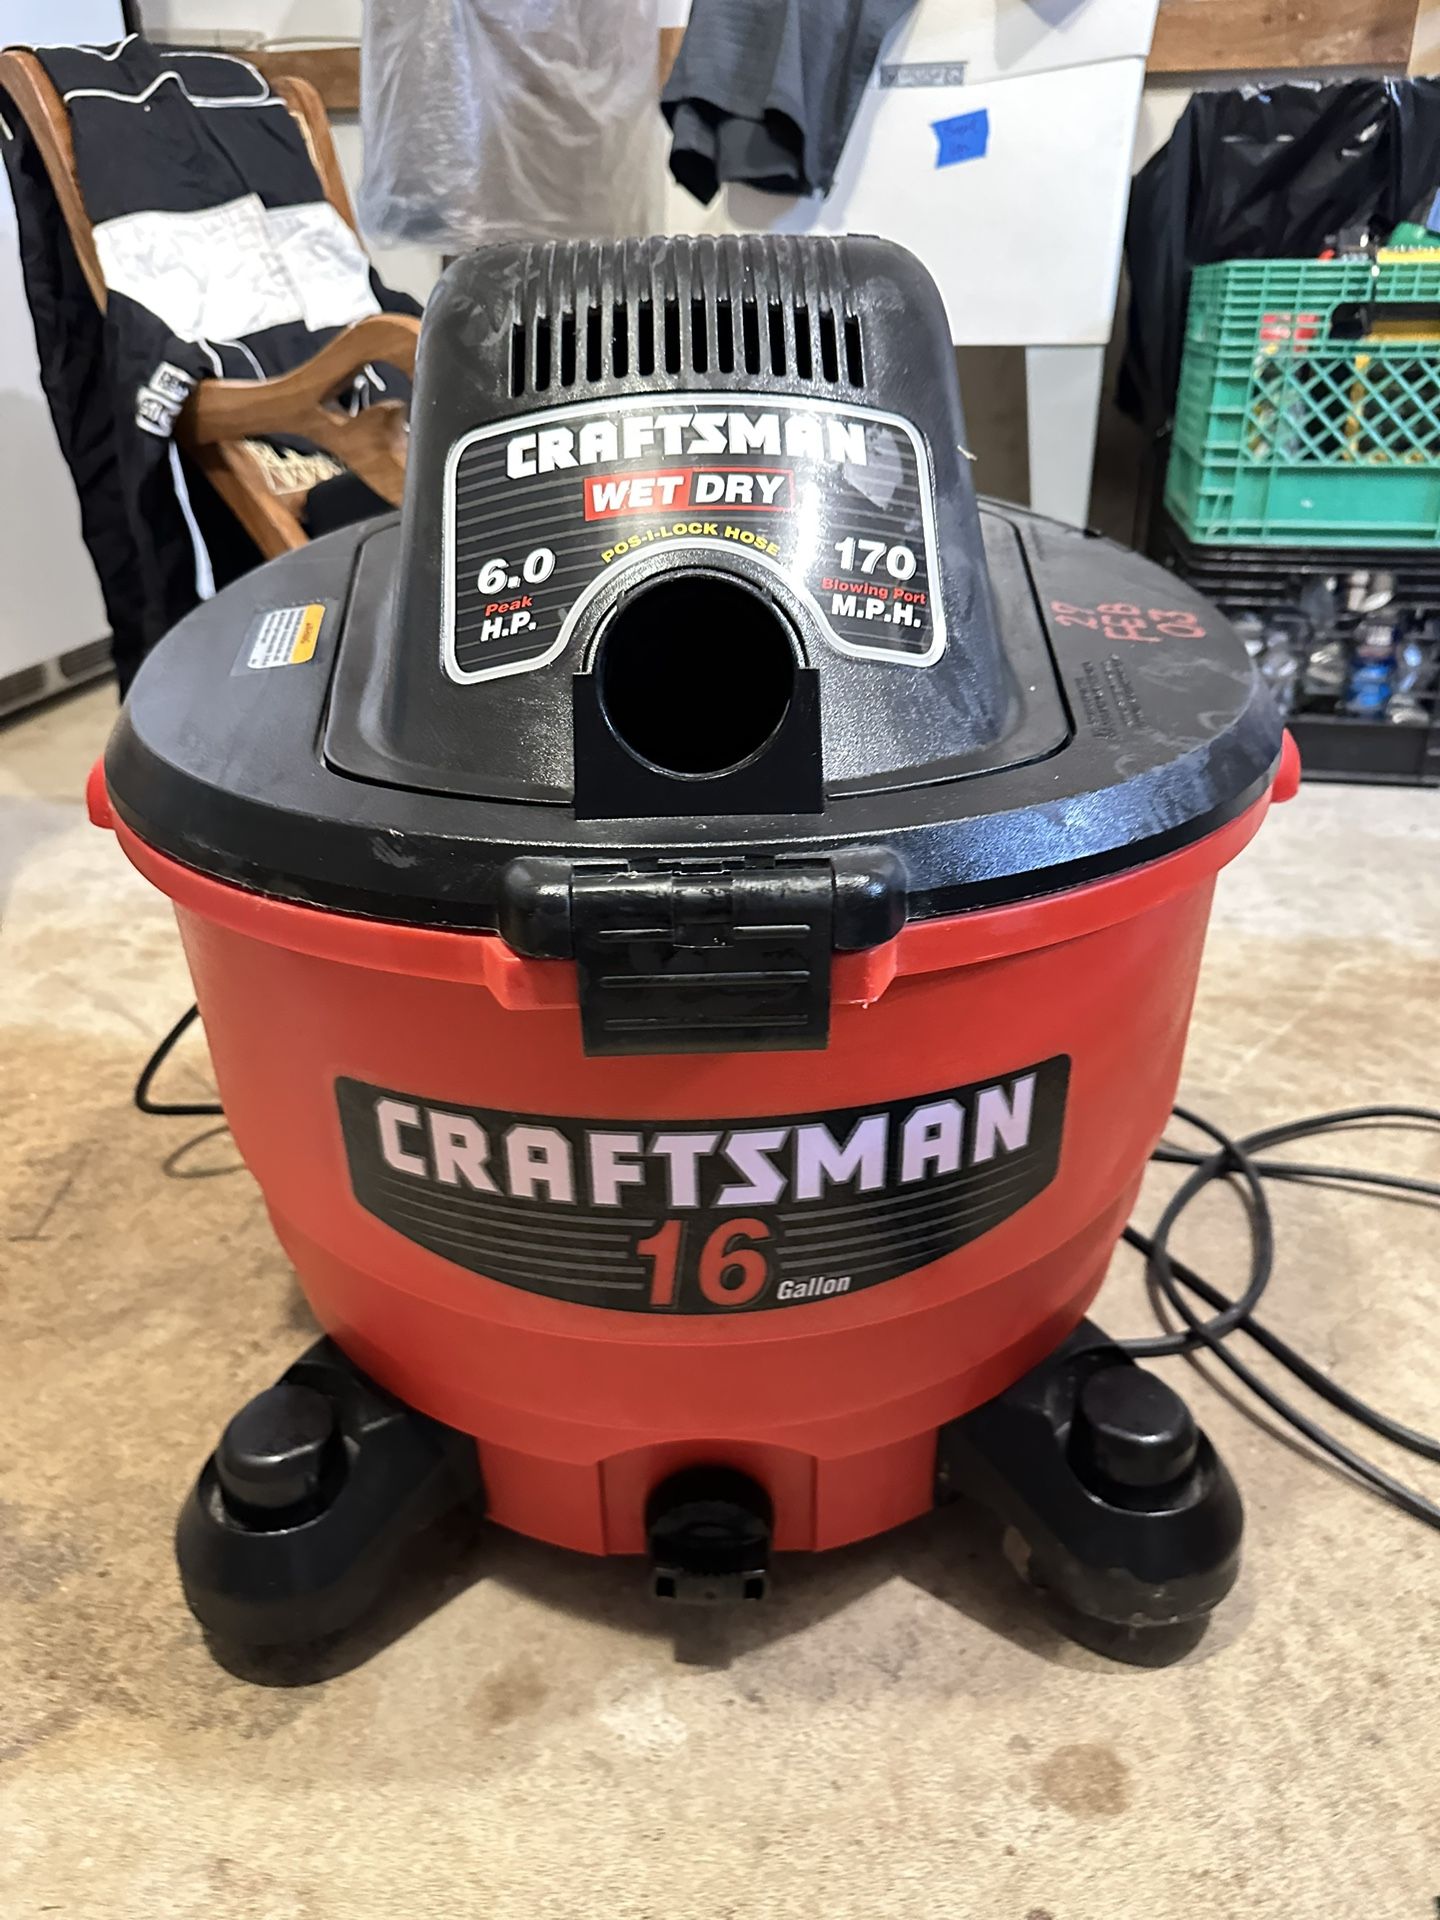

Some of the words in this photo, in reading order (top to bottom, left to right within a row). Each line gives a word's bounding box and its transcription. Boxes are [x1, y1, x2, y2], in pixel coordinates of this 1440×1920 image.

[506, 412, 868, 479] CRAFTSMAN
[592, 475, 685, 513] WET
[695, 474, 785, 504] DRY
[601, 522, 718, 563] POS-I-LOCK
[724, 524, 781, 557] HOSE
[834, 535, 917, 581] 170
[477, 547, 557, 595] 6.0
[821, 576, 889, 600] Blowing
[892, 590, 927, 606] Port
[484, 594, 534, 617] Peak
[831, 593, 922, 628] M.P.H.
[1096, 602, 1164, 642] FEB
[479, 610, 537, 642] H.P.
[374, 1072, 1036, 1209] CRAFTSMAN
[636, 1217, 774, 1309] 16
[776, 1275, 851, 1301] Gallon
